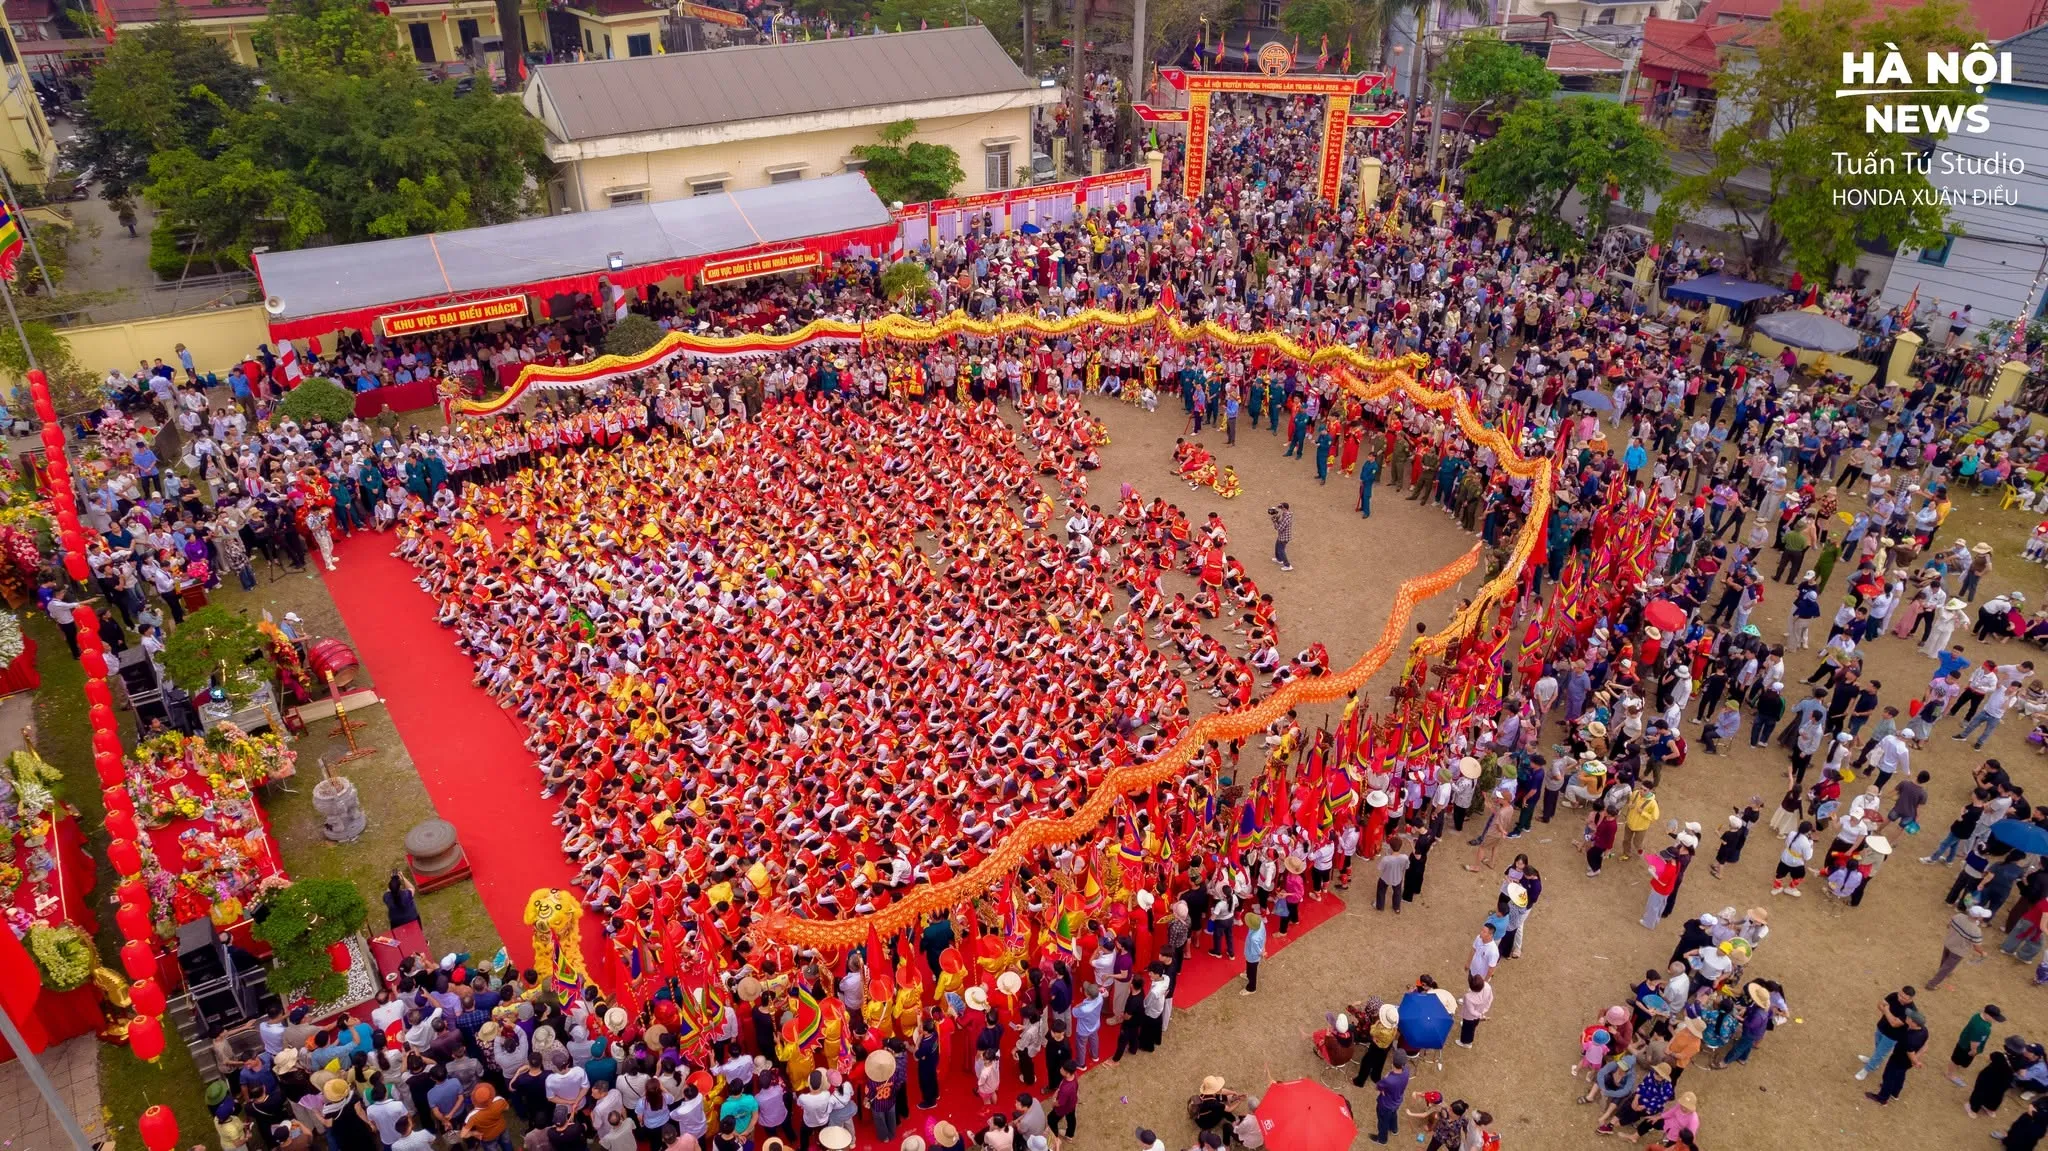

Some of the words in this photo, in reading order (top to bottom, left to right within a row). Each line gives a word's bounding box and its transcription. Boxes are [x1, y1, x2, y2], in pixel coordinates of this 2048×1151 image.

[708, 270, 720, 279] KHU
[721, 267, 732, 278] VỰC
[762, 260, 771, 269] GHI
[772, 257, 788, 268] NHẬN
[789, 254, 804, 265] CÔNG
[393, 317, 415, 331] KHU
[418, 314, 437, 328] VỰC
[439, 311, 457, 326] ĐẠI
[460, 306, 482, 322] BIỂU
[485, 302, 518, 316] KHÁCH
